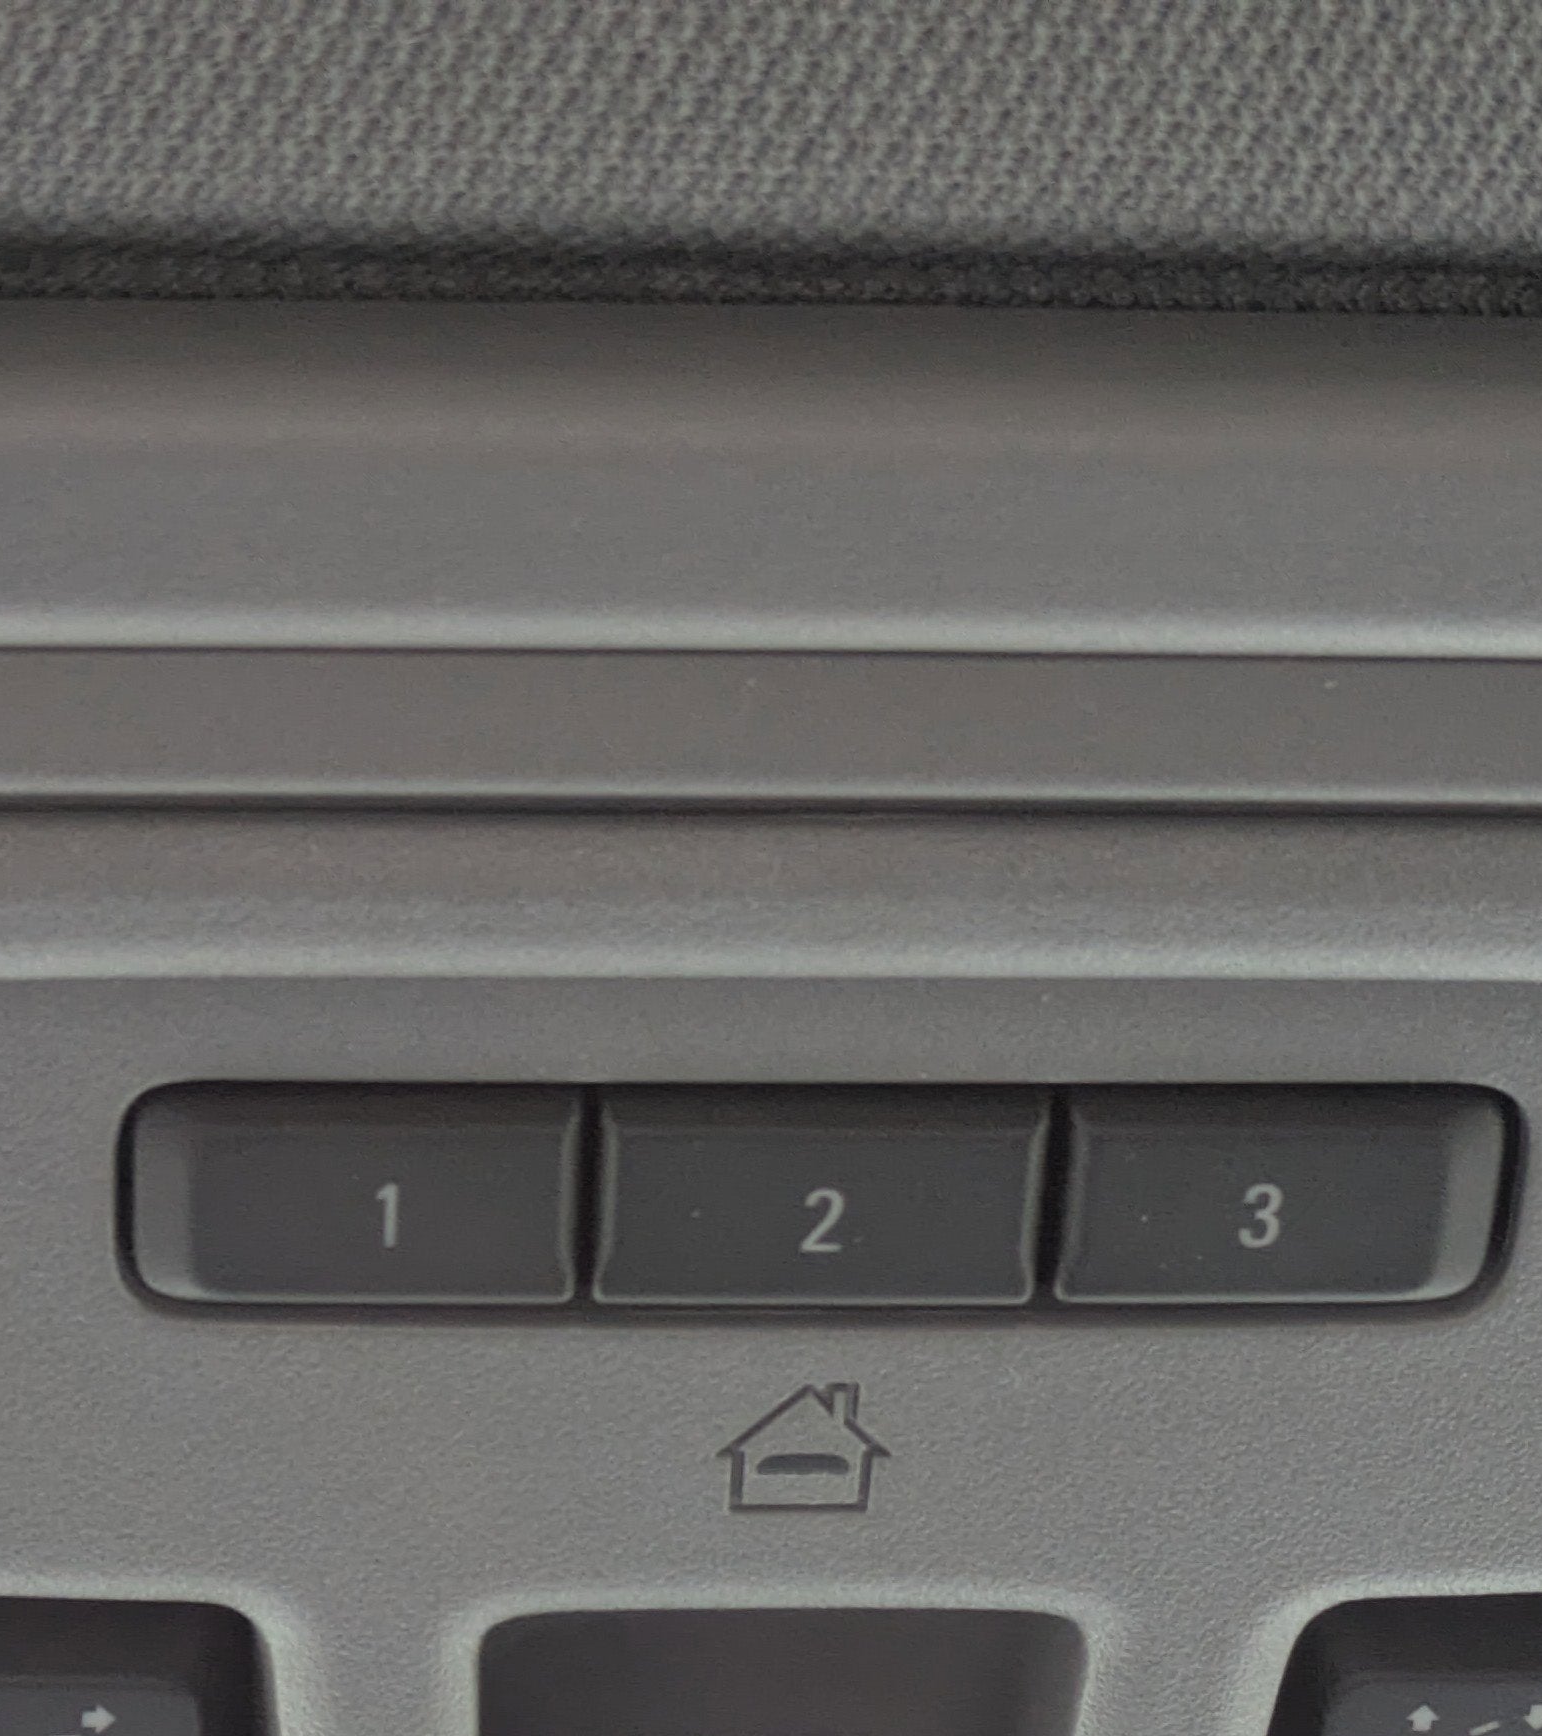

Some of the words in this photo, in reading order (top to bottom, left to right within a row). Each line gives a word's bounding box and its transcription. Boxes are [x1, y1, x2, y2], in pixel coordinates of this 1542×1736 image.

[373, 1183, 401, 1248] 1
[799, 1188, 848, 1254] 2
[1237, 1183, 1284, 1248] 3
